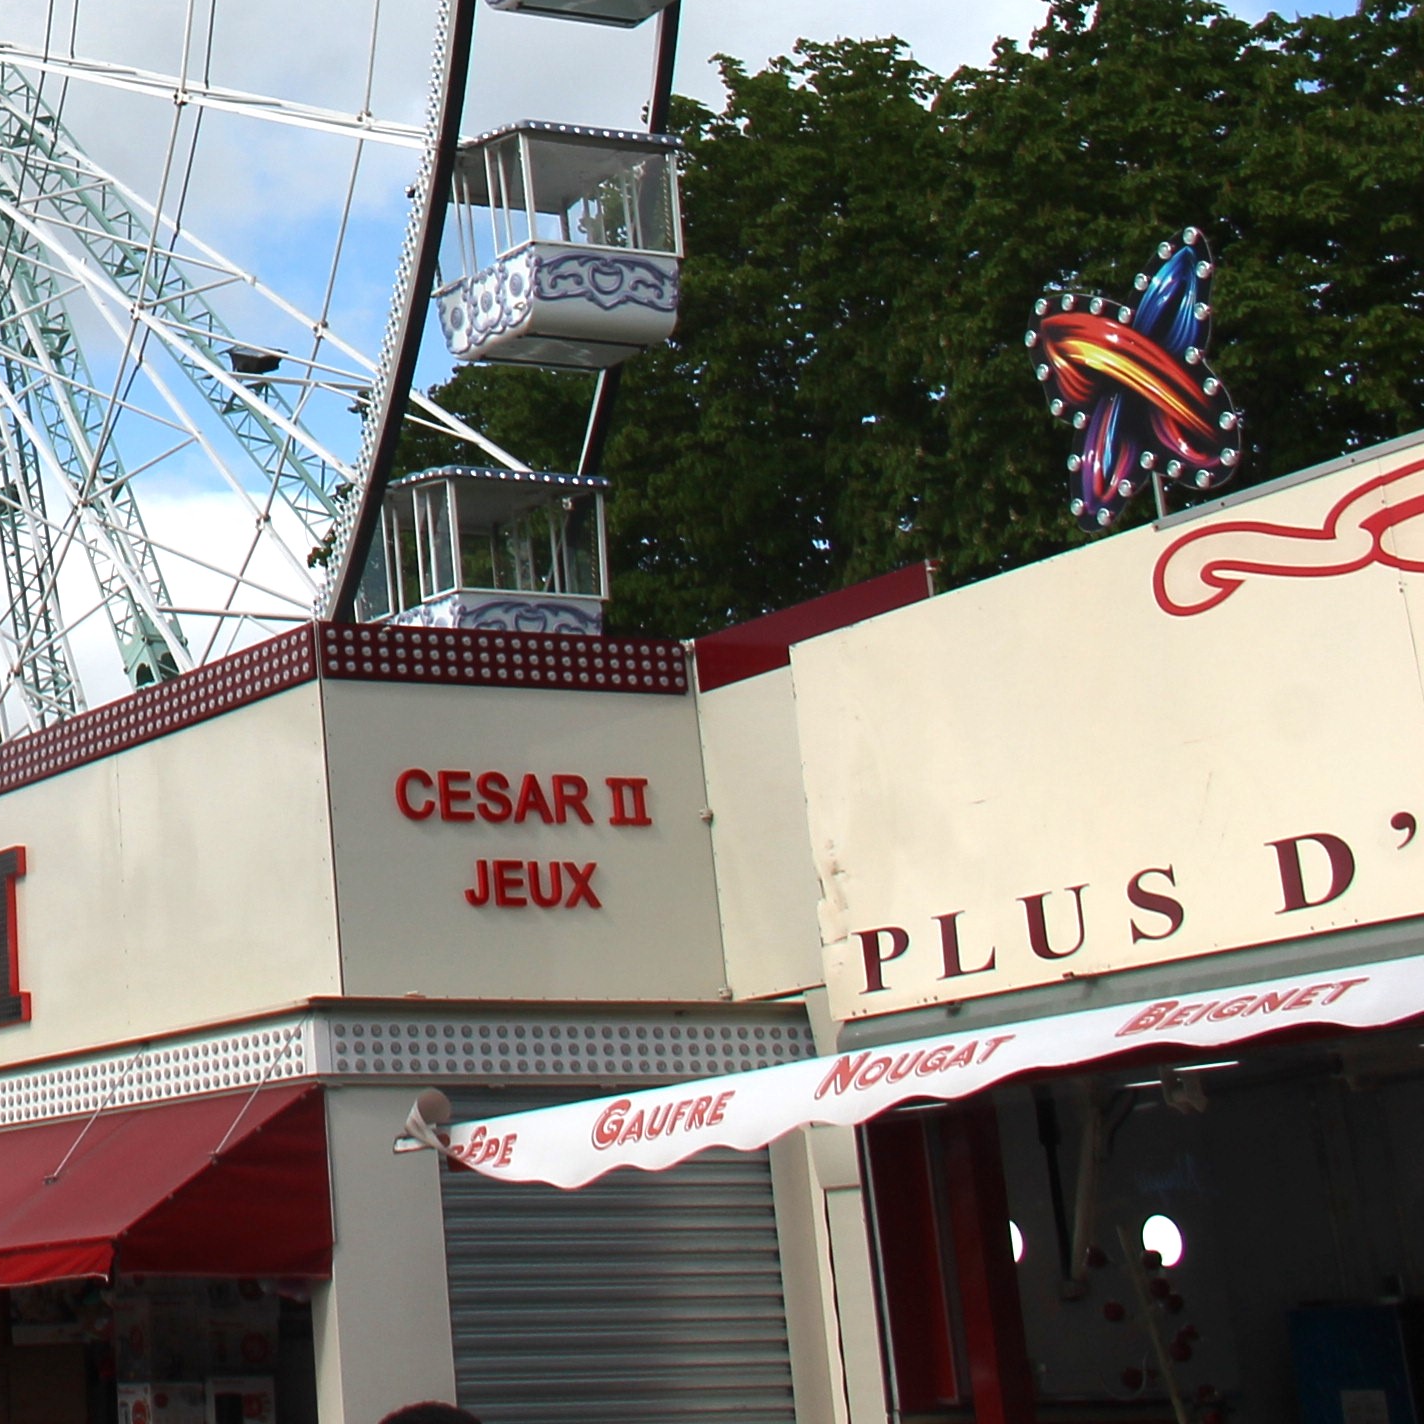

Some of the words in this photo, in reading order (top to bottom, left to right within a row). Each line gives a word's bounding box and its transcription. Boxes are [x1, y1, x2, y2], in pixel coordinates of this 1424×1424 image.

[395, 767, 594, 825] CESAR
[605, 777, 652, 826] II
[464, 859, 602, 909] JEUX
[851, 864, 1184, 995] PLUS
[438, 1125, 518, 1169] ÊPE
[591, 1089, 736, 1152] GAUFRE
[813, 1034, 1017, 1102] NOUGAT
[1115, 977, 1371, 1038] BEIGNET
